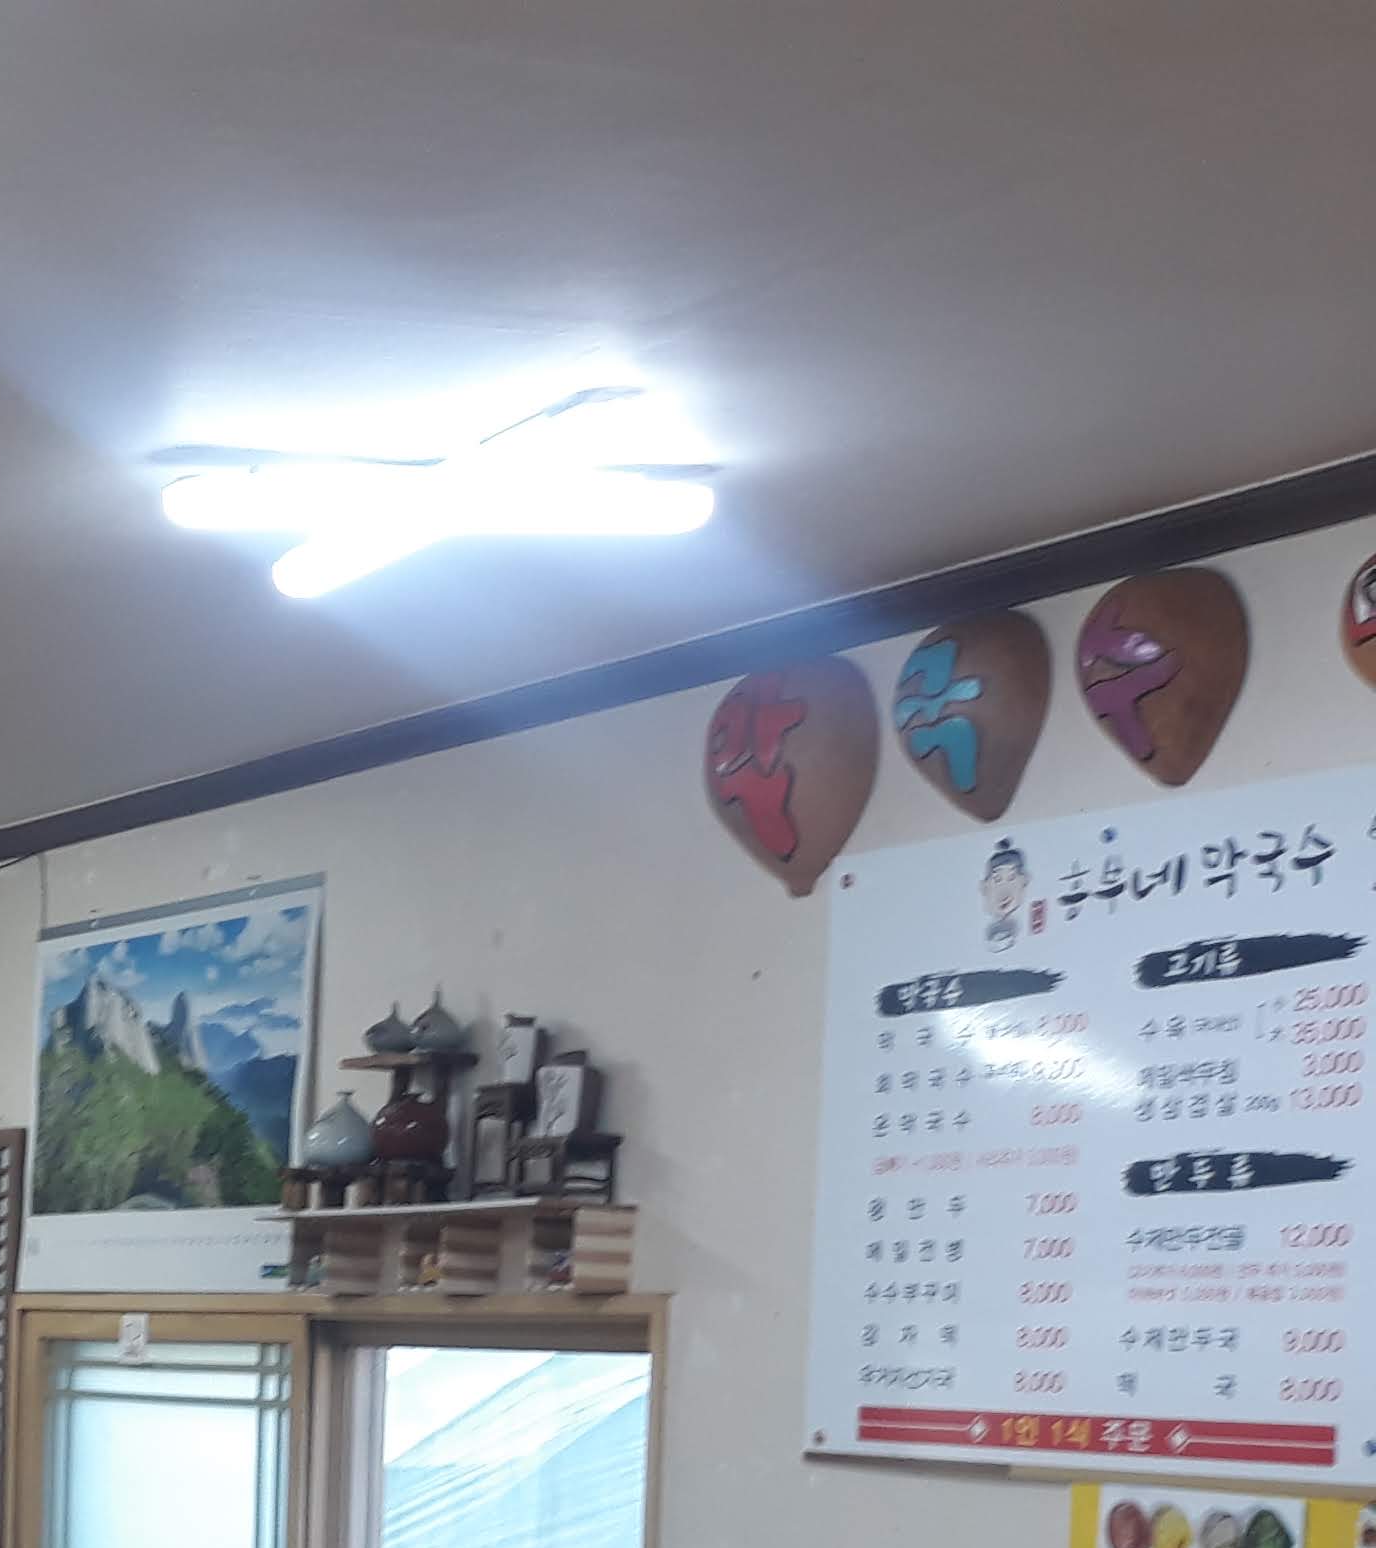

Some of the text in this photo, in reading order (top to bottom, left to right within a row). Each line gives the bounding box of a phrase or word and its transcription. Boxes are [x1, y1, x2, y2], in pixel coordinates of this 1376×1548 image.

[1056, 853, 1189, 922] 흥부네
[1200, 823, 1338, 899] 막국수
[1164, 942, 1242, 977] 고기류
[897, 975, 963, 1009] 막국수
[1099, 1419, 1152, 1452] 주문
